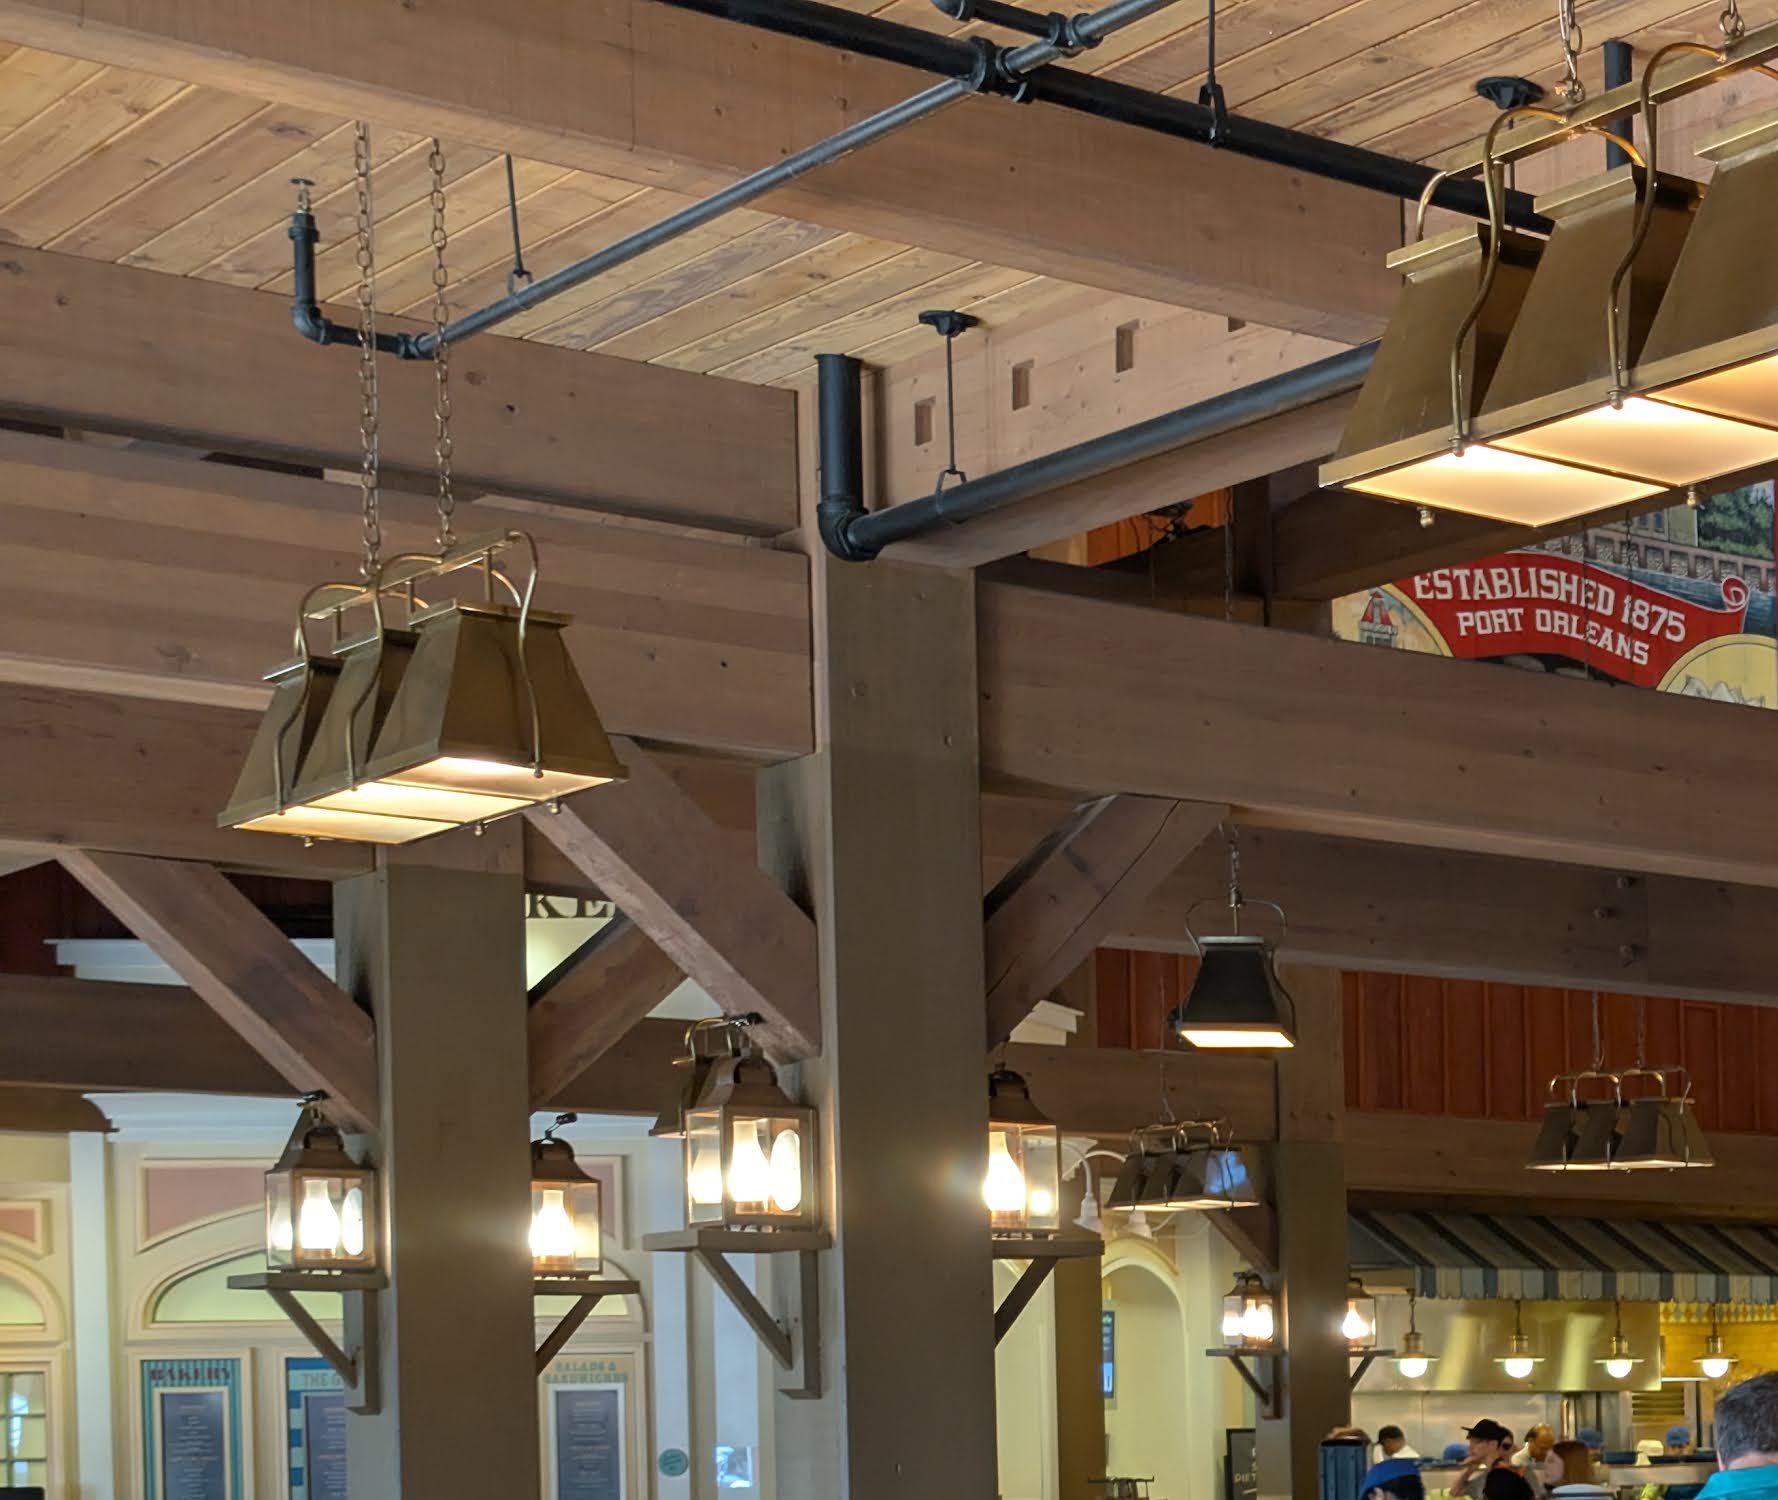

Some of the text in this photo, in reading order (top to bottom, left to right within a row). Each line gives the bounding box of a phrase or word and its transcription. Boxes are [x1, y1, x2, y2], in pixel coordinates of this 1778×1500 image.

[1414, 566, 1687, 644] ESTABLISHED 1875
[1456, 607, 1651, 667] PORT ORLEANS
